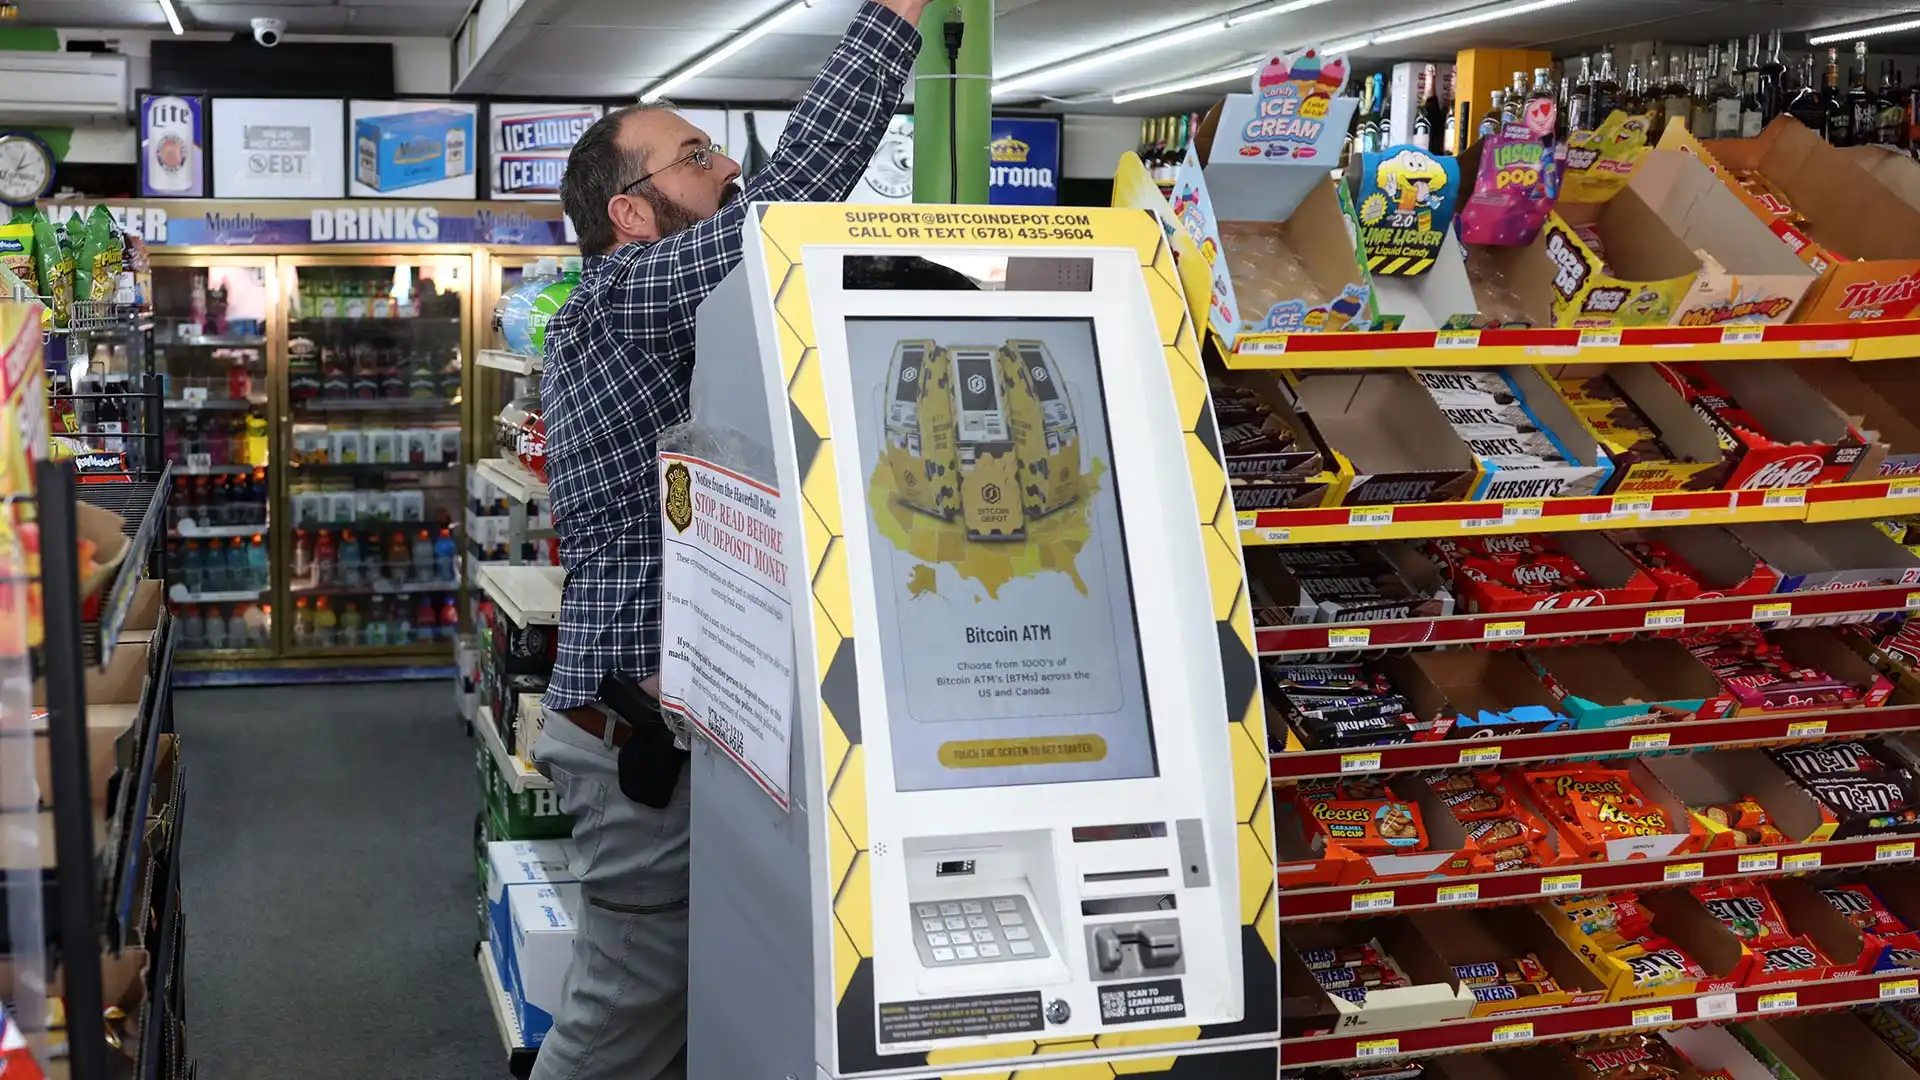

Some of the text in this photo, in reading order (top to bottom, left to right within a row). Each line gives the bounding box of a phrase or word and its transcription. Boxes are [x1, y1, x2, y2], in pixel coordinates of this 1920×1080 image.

[153, 104, 190, 128] Lite
[1260, 98, 1297, 117] ICE
[1246, 119, 1320, 139] CREAM
[269, 155, 307, 174] EBT
[310, 207, 439, 242] DRINKS
[845, 211, 1090, 226] SUPPORT@BITCOINDEPOT.COM
[1391, 214, 1414, 228] 2.0
[848, 226, 1094, 240] CALL OR TEXT (678) 435-9604
[1376, 245, 1401, 257] Liquid
[1402, 247, 1430, 258] Candy
[1807, 255, 1828, 275] 12
[1838, 275, 1920, 312] Twix
[1271, 313, 1302, 327] ICE
[1833, 455, 1858, 464] SIZE
[1836, 447, 1862, 455] KING
[695, 471, 712, 489] Notice
[734, 486, 760, 511] Haverhill
[1358, 480, 1437, 501] HERSHEY'S
[1486, 478, 1565, 500] HERSHEY'S
[720, 502, 744, 533] READ
[747, 515, 783, 555] BEFORE
[695, 516, 788, 587] YOU DEPOSIT MONEY
[1483, 536, 1531, 553] KitKat
[1512, 564, 1561, 585] KitKat
[1301, 576, 1378, 596] HERSHEY'S
[966, 624, 1052, 644] Bitcoin ATM
[957, 657, 1067, 671] Choose from 1000's of
[937, 676, 970, 686] Bitcoin
[974, 674, 1003, 684] ATM's
[1041, 672, 1072, 682] across
[1074, 671, 1090, 680] the
[978, 686, 1053, 698] US and Canada.
[1556, 775, 1624, 797] Reese's
[1312, 803, 1370, 823] Reese's
[1598, 802, 1667, 829] Reese's
[1331, 829, 1364, 838] BIG CUP
[1127, 988, 1159, 998] SCAN TO
[1128, 995, 1176, 1007] LEARN MORE
[1129, 1003, 1184, 1016] & GET STARTED
[1343, 1015, 1359, 1027] 24
[1590, 1046, 1650, 1070] TWIX
